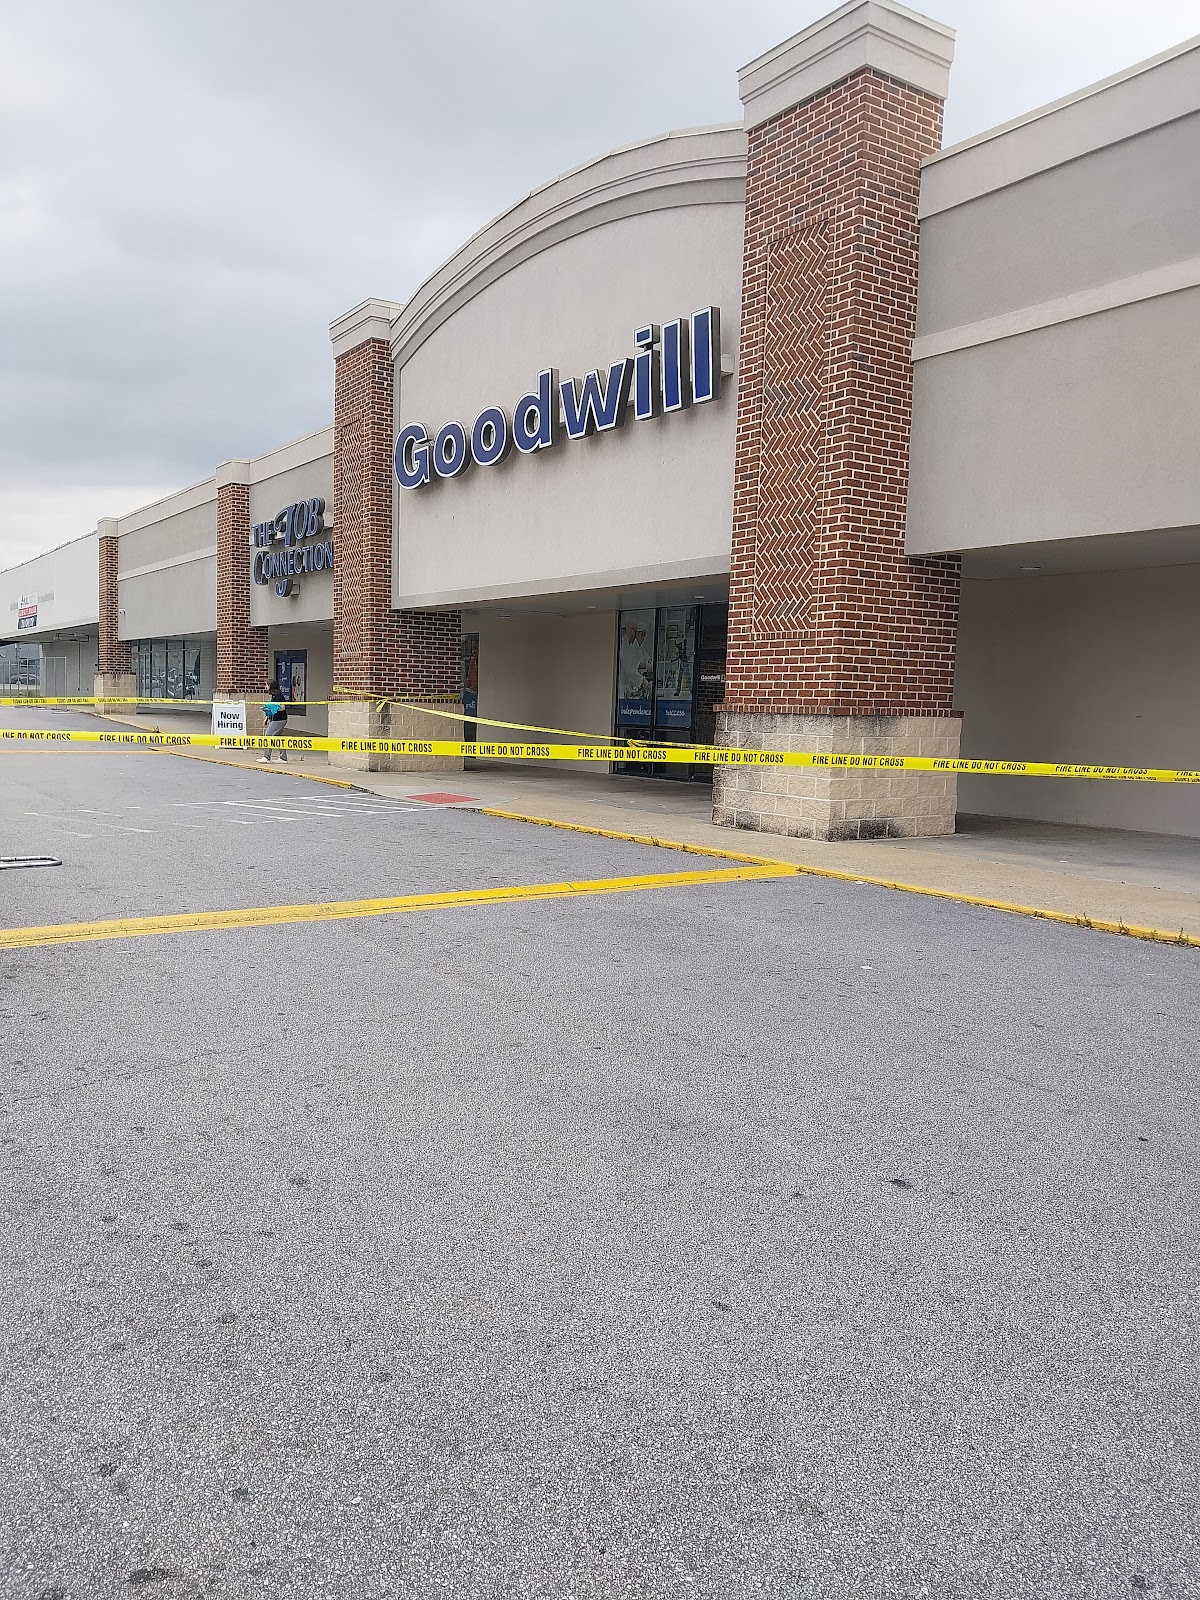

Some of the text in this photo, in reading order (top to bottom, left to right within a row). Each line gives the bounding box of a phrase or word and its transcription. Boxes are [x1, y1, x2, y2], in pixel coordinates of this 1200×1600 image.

[394, 305, 717, 490] Goodwill
[252, 521, 274, 548] THE
[253, 541, 334, 586] CONNECTION
[220, 711, 240, 720] Now
[217, 720, 244, 731] Hiring
[220, 738, 313, 749] FIRE LINE DO NOT CROSS
[341, 741, 433, 753] FIRE LINE DO NOT CROSS
[460, 744, 550, 757] FIRE LINE DO NOT CROSS
[577, 748, 667, 760] FIRE LINE DO NOT CROSS
[694, 752, 784, 763] FIRE LINE DO NOT CROSS
[812, 756, 905, 767] FIRE LINE DO NOT CROSS
[933, 760, 1027, 771] FIRE LINE DO NOT CROSS
